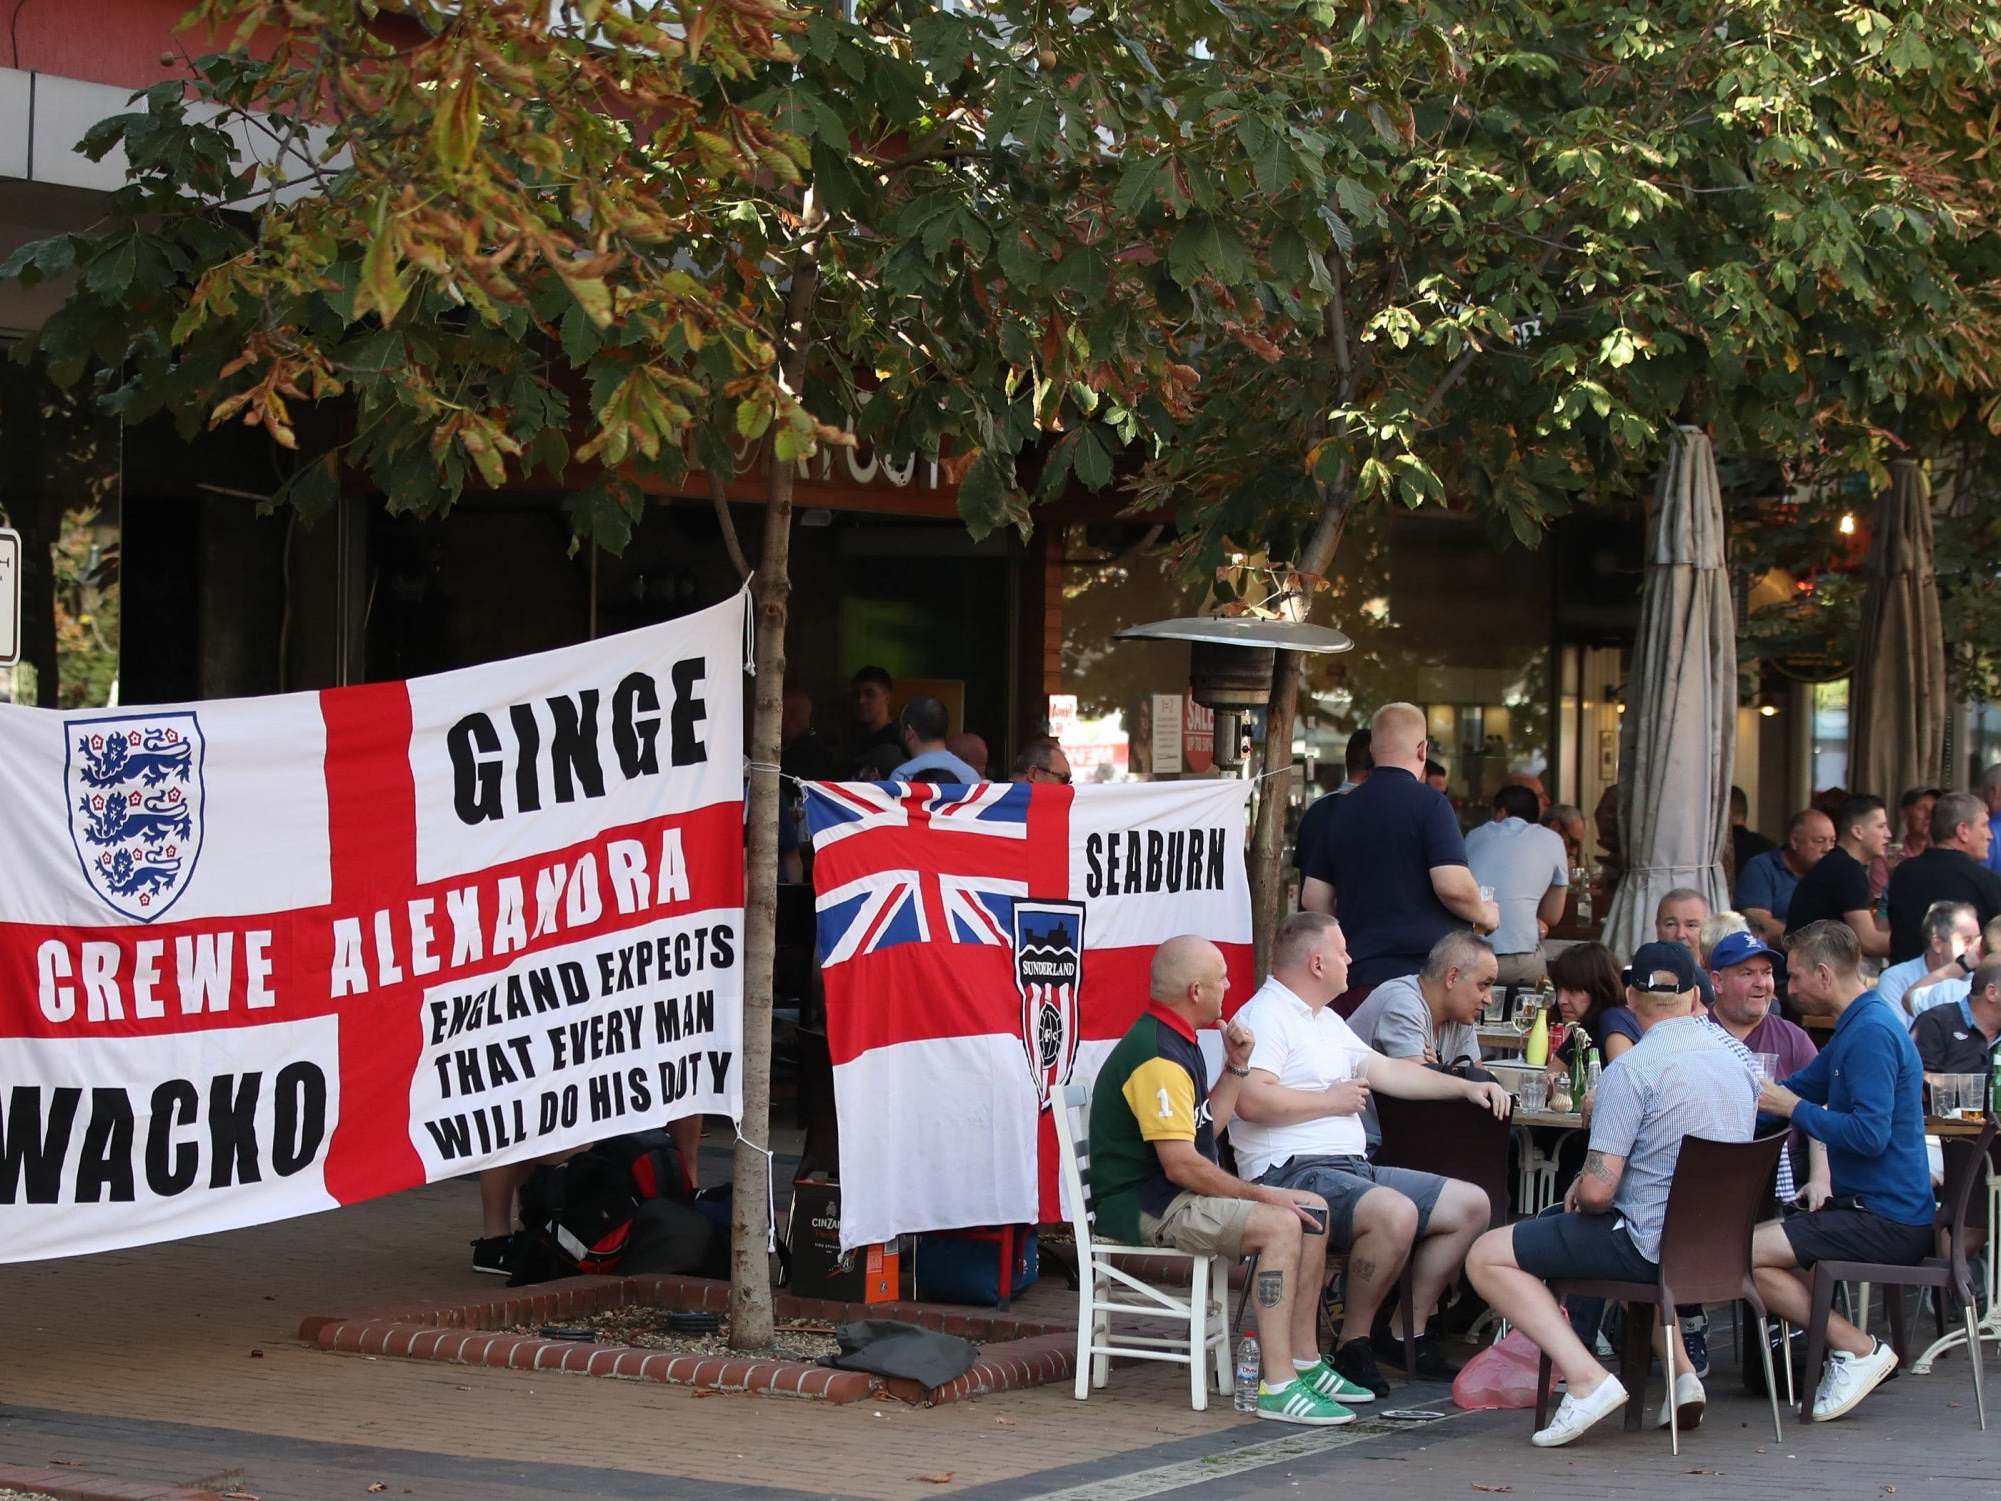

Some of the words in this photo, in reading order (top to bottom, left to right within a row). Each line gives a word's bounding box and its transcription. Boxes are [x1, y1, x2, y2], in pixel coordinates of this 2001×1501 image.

[447, 656, 708, 825] GINGE
[1086, 828, 1226, 898] SEABURN
[37, 930, 275, 1022] CREWE
[331, 827, 690, 999] ALEXANDRA
[1023, 961, 1075, 977] SUNDERLAND
[430, 961, 590, 1046] ENGLAND
[596, 924, 735, 997] EXPECTS
[434, 1035, 536, 1099] THAT
[547, 1005, 643, 1072] EVERY
[654, 990, 714, 1044] MAN
[0, 1061, 326, 1204] WACKO
[424, 1100, 527, 1160] WILL
[538, 1084, 578, 1136] DO
[588, 1067, 652, 1123] HIS
[658, 1051, 732, 1105] DUTY
[1157, 1088, 1174, 1117] 1
